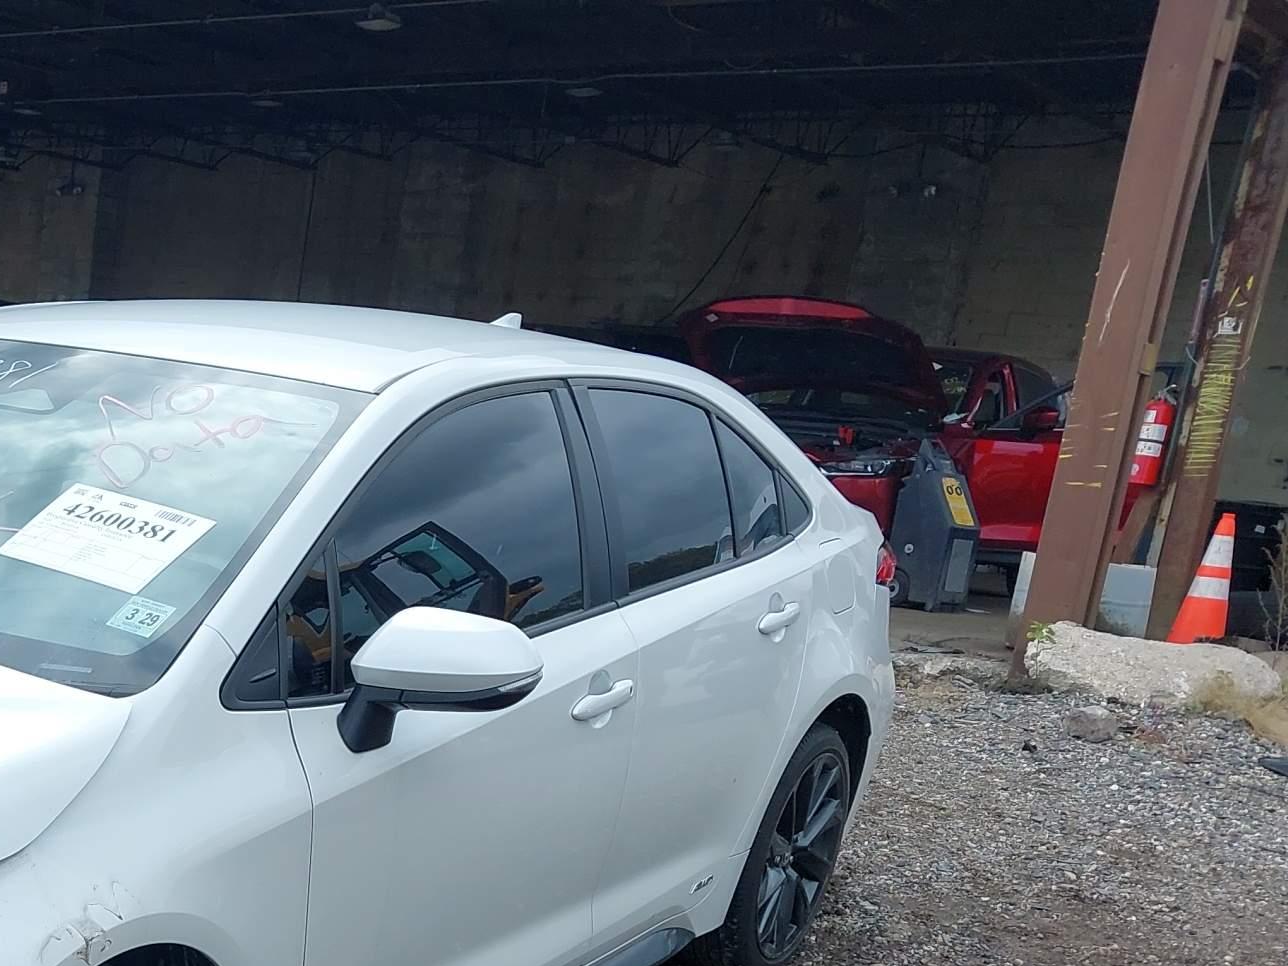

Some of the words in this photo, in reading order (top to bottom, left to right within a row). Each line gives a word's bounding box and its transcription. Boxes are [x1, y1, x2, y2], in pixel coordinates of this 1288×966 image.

[63, 503, 177, 542] 42600381
[125, 608, 140, 620] 3
[138, 612, 160, 626] 29
